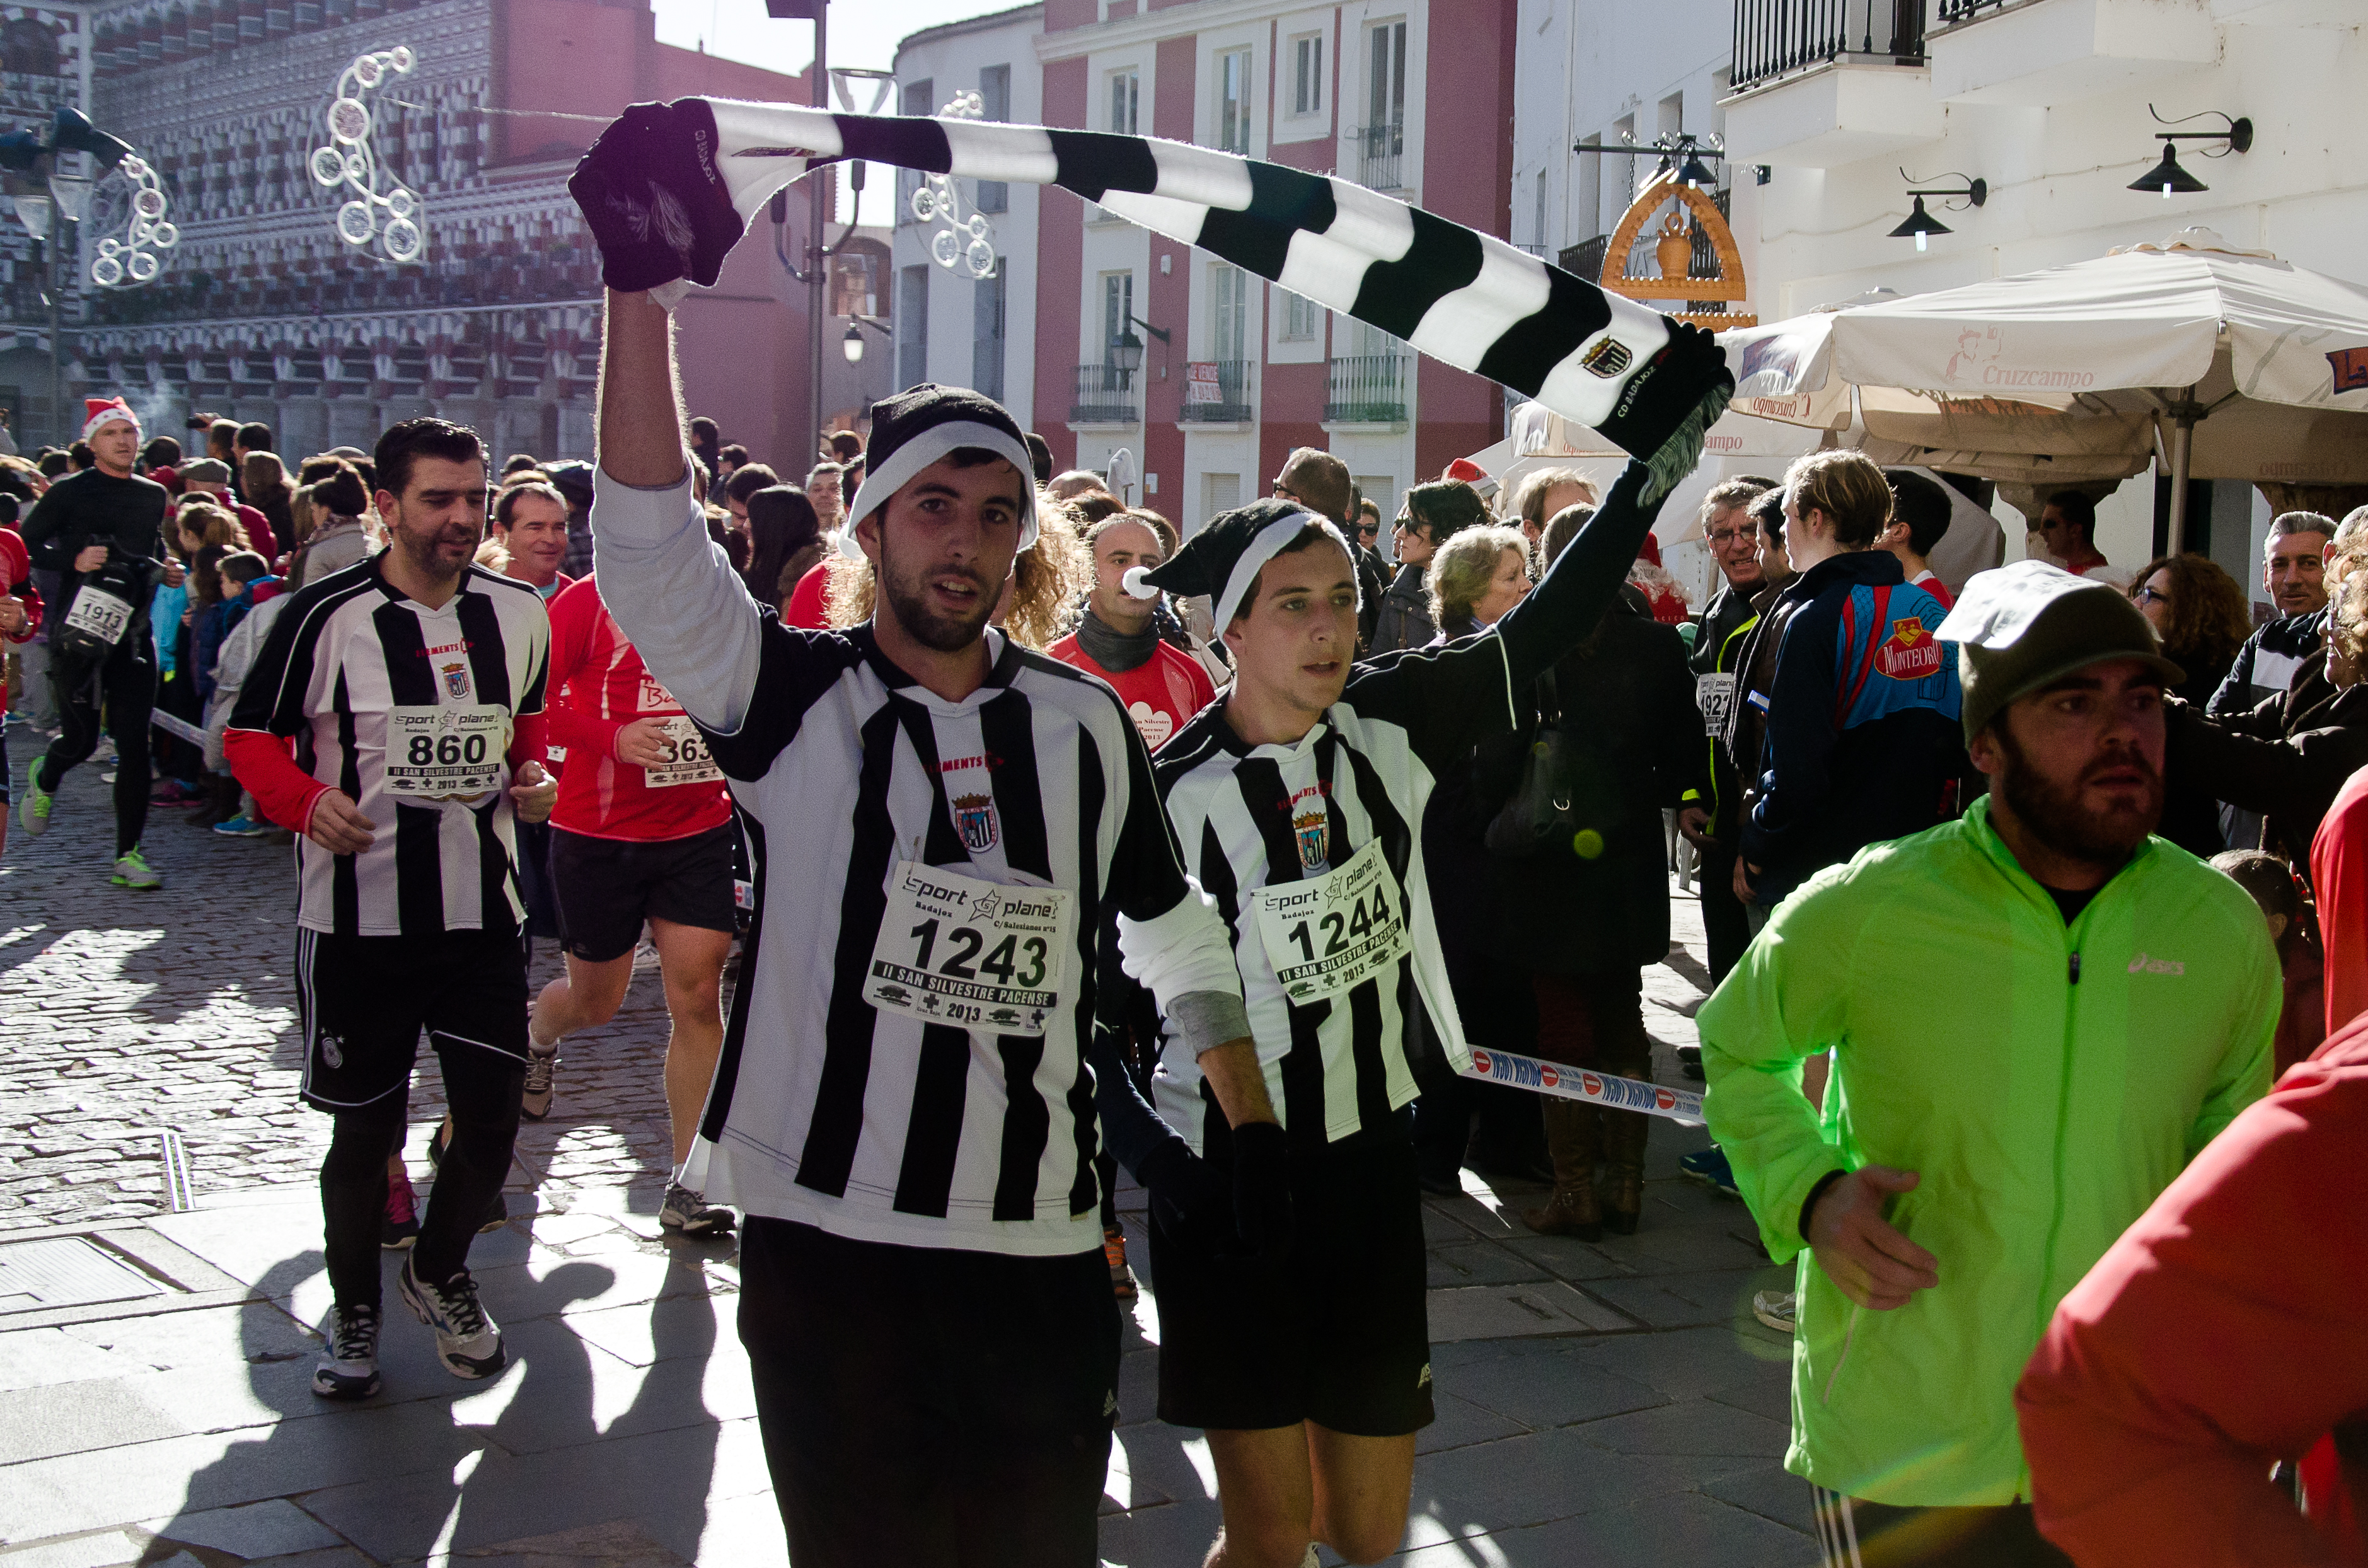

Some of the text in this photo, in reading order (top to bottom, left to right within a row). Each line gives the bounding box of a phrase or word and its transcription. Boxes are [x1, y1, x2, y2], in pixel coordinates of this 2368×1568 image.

[1983, 366, 2094, 389] Cruzcampo
[1617, 366, 1656, 418] CD BADAJOZ
[83, 603, 123, 628] 1913
[408, 734, 487, 766] 860
[403, 768, 420, 776] SAN
[423, 767, 463, 776] SILVESTRE
[465, 764, 497, 775] PACENSE
[437, 780, 457, 790] 2013
[915, 901, 953, 918] Badajoz
[1281, 909, 1315, 920] Badajoz
[1288, 883, 1390, 962] 1244
[910, 918, 1048, 988] 1243
[1282, 970, 1291, 983] II
[1294, 965, 1317, 980] SAN
[1321, 945, 1368, 972] SILVESTRE
[1369, 921, 1398, 950] PACENSE
[1343, 962, 1365, 983] 2013
[882, 965, 1049, 1006] II SAN SILVESTRE PACENSE
[946, 1003, 981, 1021] 2013
